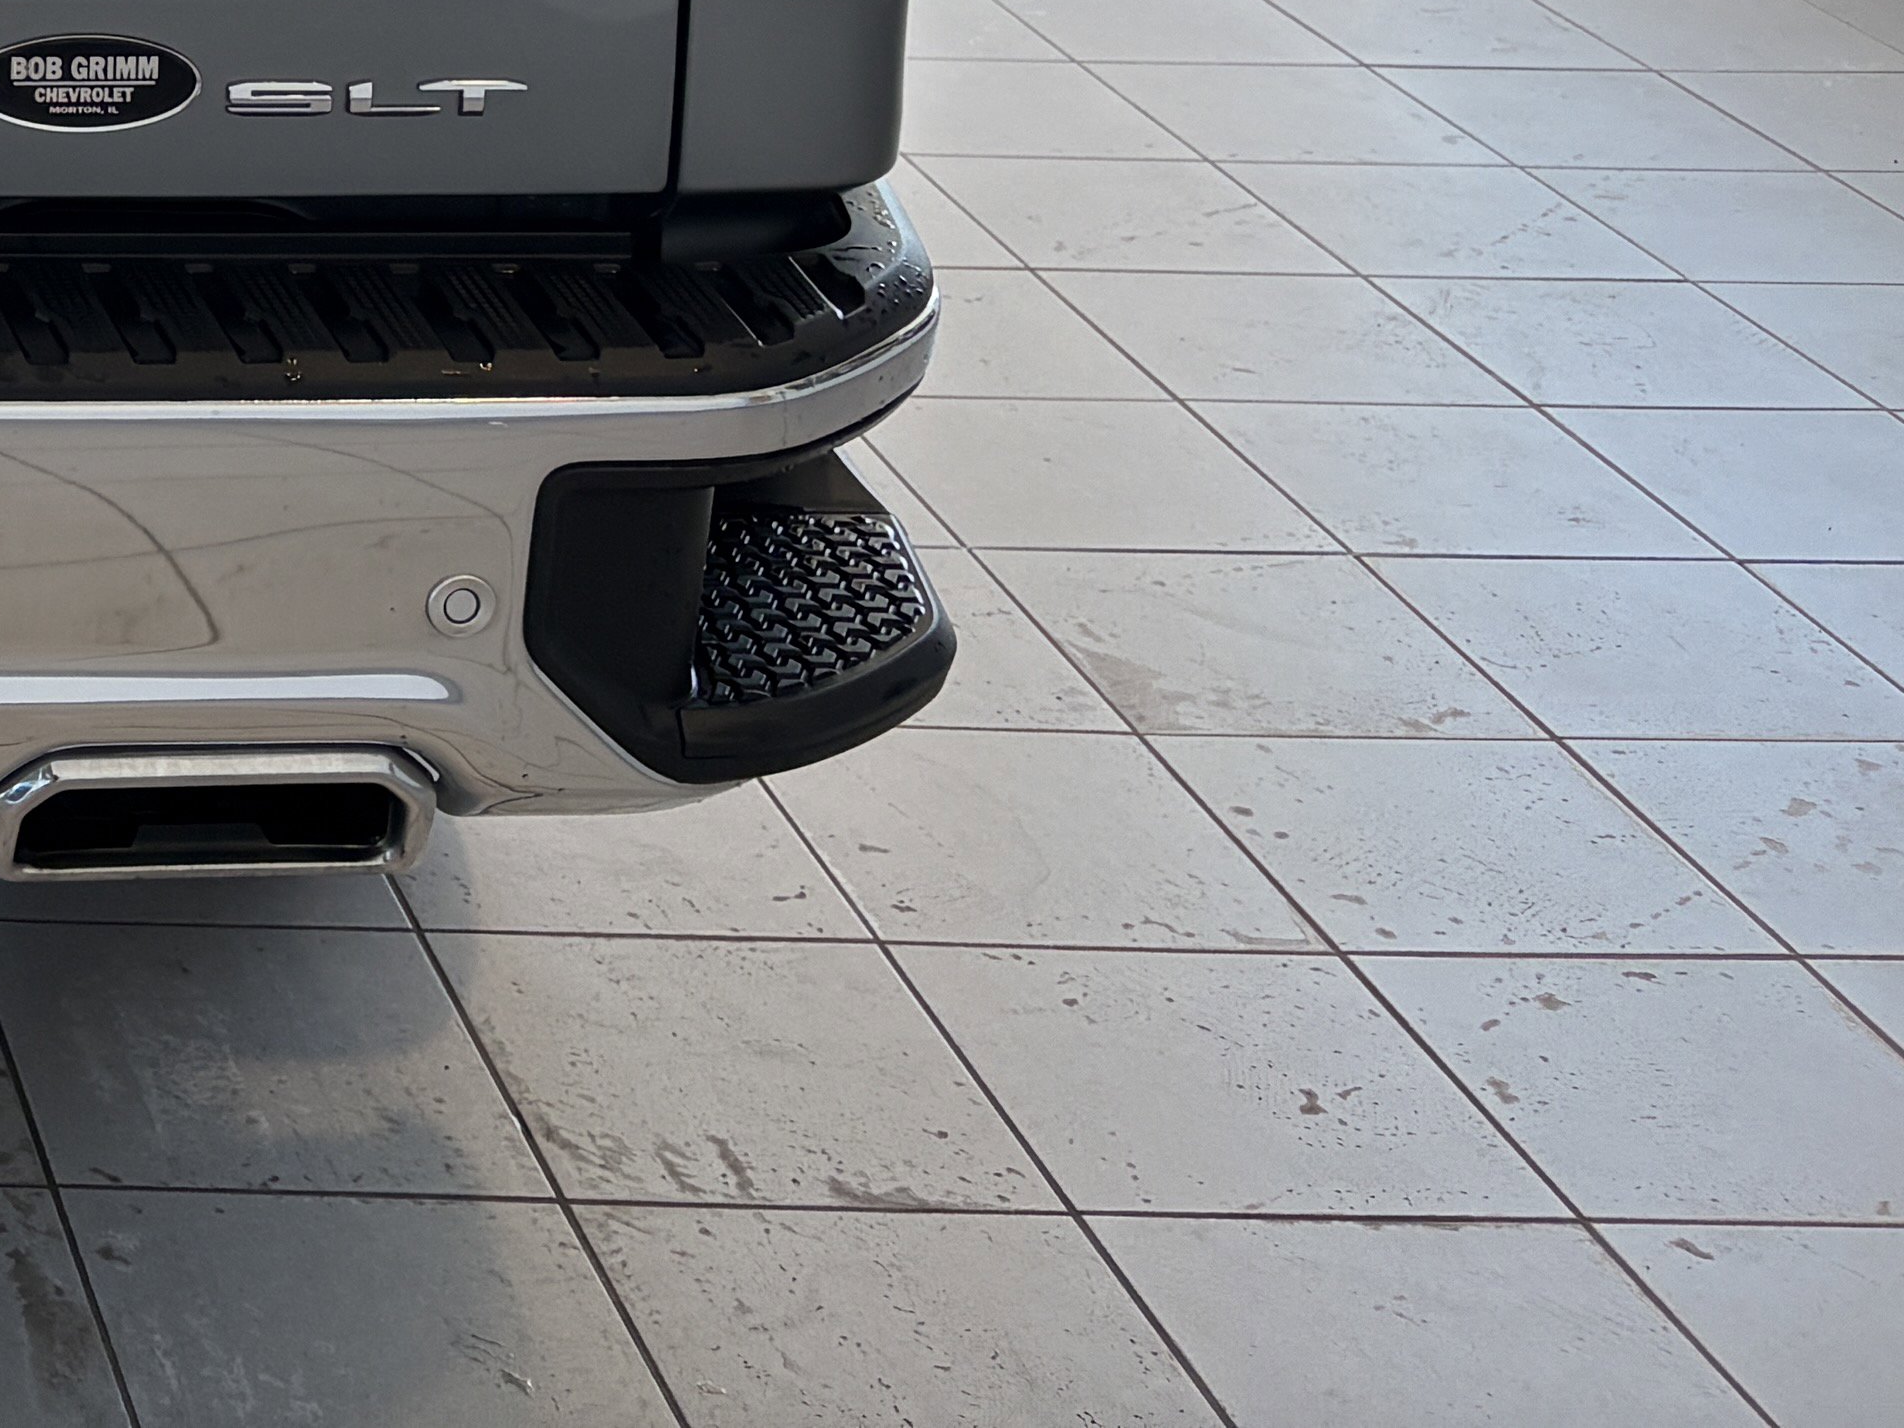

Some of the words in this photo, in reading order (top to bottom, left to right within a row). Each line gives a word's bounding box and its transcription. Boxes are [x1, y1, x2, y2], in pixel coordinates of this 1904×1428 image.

[9, 55, 63, 80] BOB
[70, 55, 160, 80] GRIMM
[34, 86, 135, 104] CHEVROLET
[225, 77, 529, 117] SLT
[48, 105, 105, 116] MORTON,
[107, 105, 120, 115] IL
